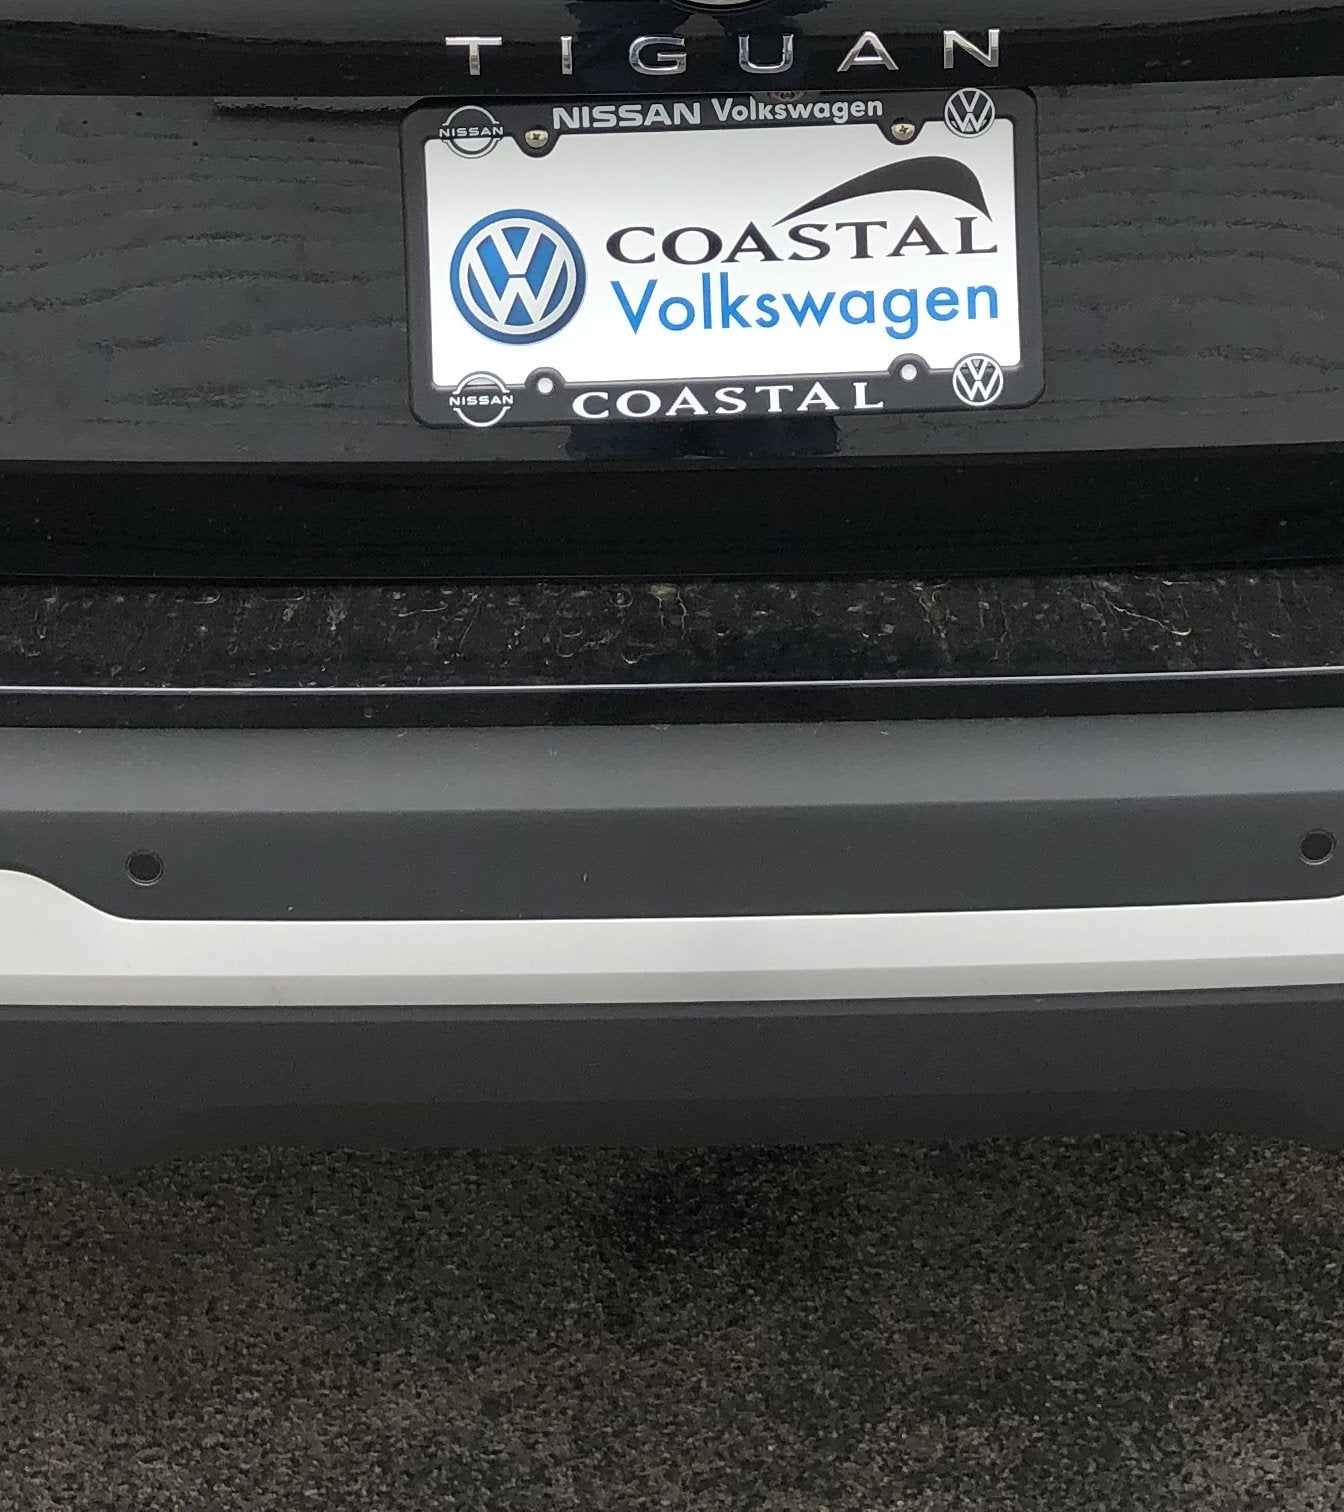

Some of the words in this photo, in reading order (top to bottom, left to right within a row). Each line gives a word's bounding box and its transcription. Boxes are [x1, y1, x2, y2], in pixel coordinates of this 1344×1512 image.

[444, 28, 1001, 77] TIGUAN
[439, 126, 503, 138] NISSAN
[552, 102, 700, 130] NISSAN
[711, 96, 883, 124] Volkswagen
[606, 215, 998, 265] COASTAL
[611, 272, 998, 340] Volkswagen
[449, 393, 514, 407] NISSAN
[572, 381, 885, 420] COASTAL
